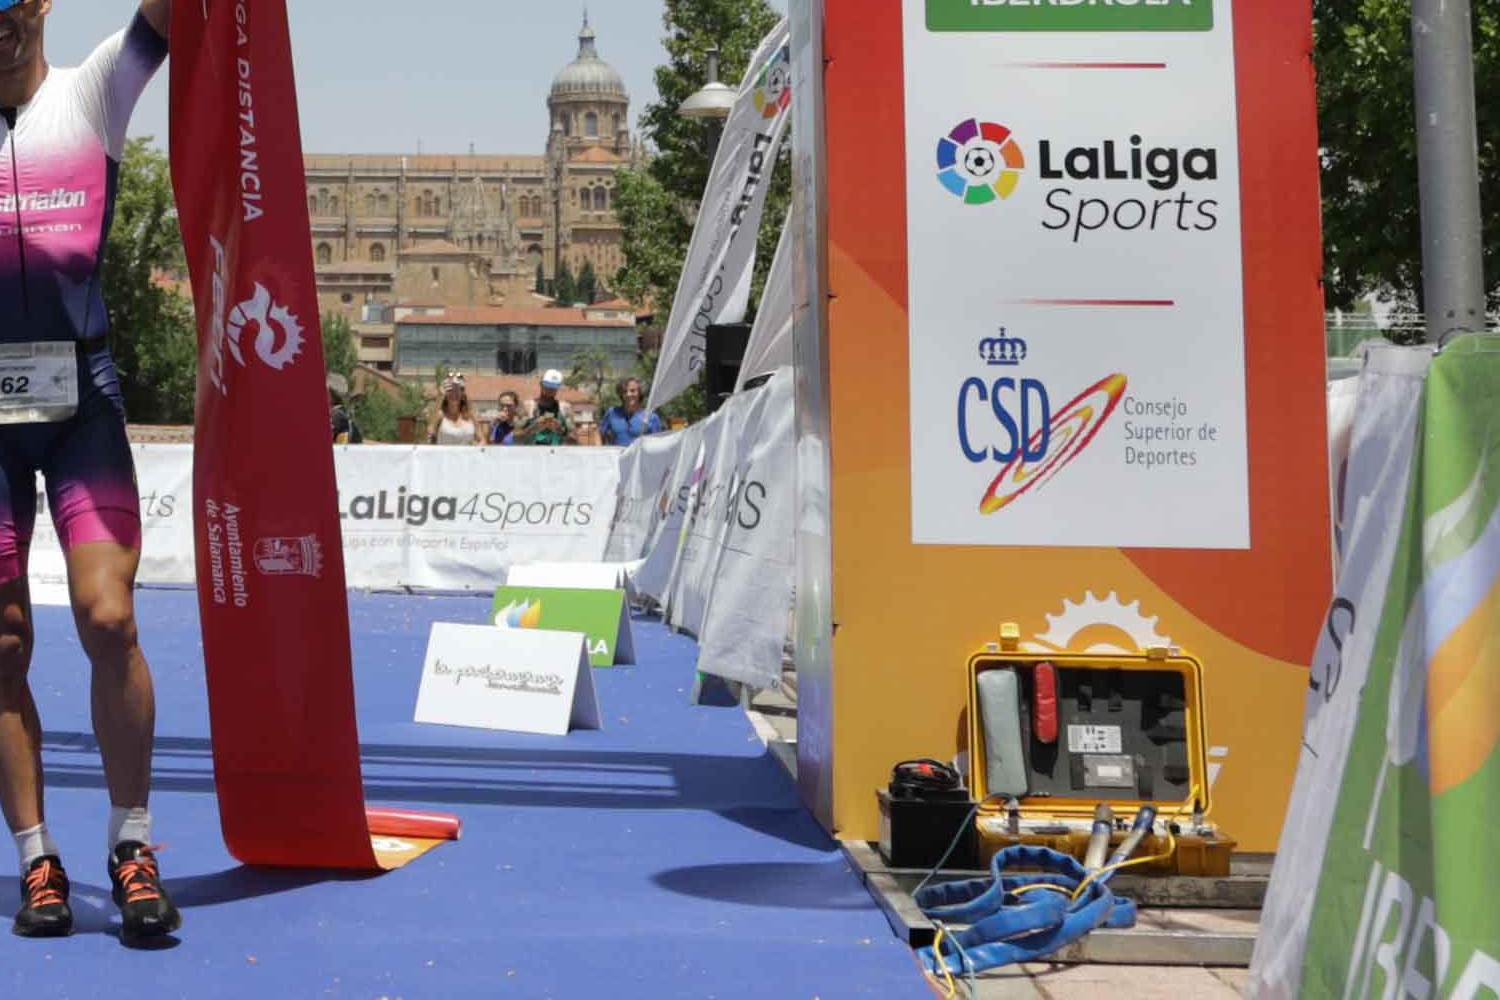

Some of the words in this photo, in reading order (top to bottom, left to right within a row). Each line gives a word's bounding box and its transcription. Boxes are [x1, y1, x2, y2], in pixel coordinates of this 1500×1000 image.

[233, 56, 265, 224] DISTANCIA
[1039, 134, 1217, 190] LaLiga
[1042, 188, 1218, 242] Sports
[958, 377, 1050, 463] CSD
[1124, 396, 1187, 420] Consejo
[1124, 422, 1192, 445] Superior
[1198, 423, 1217, 441] de
[1125, 447, 1197, 469] Deportes
[205, 498, 221, 519] de
[207, 521, 228, 604] Salamanca
[221, 503, 249, 607] Ayuntamiento
